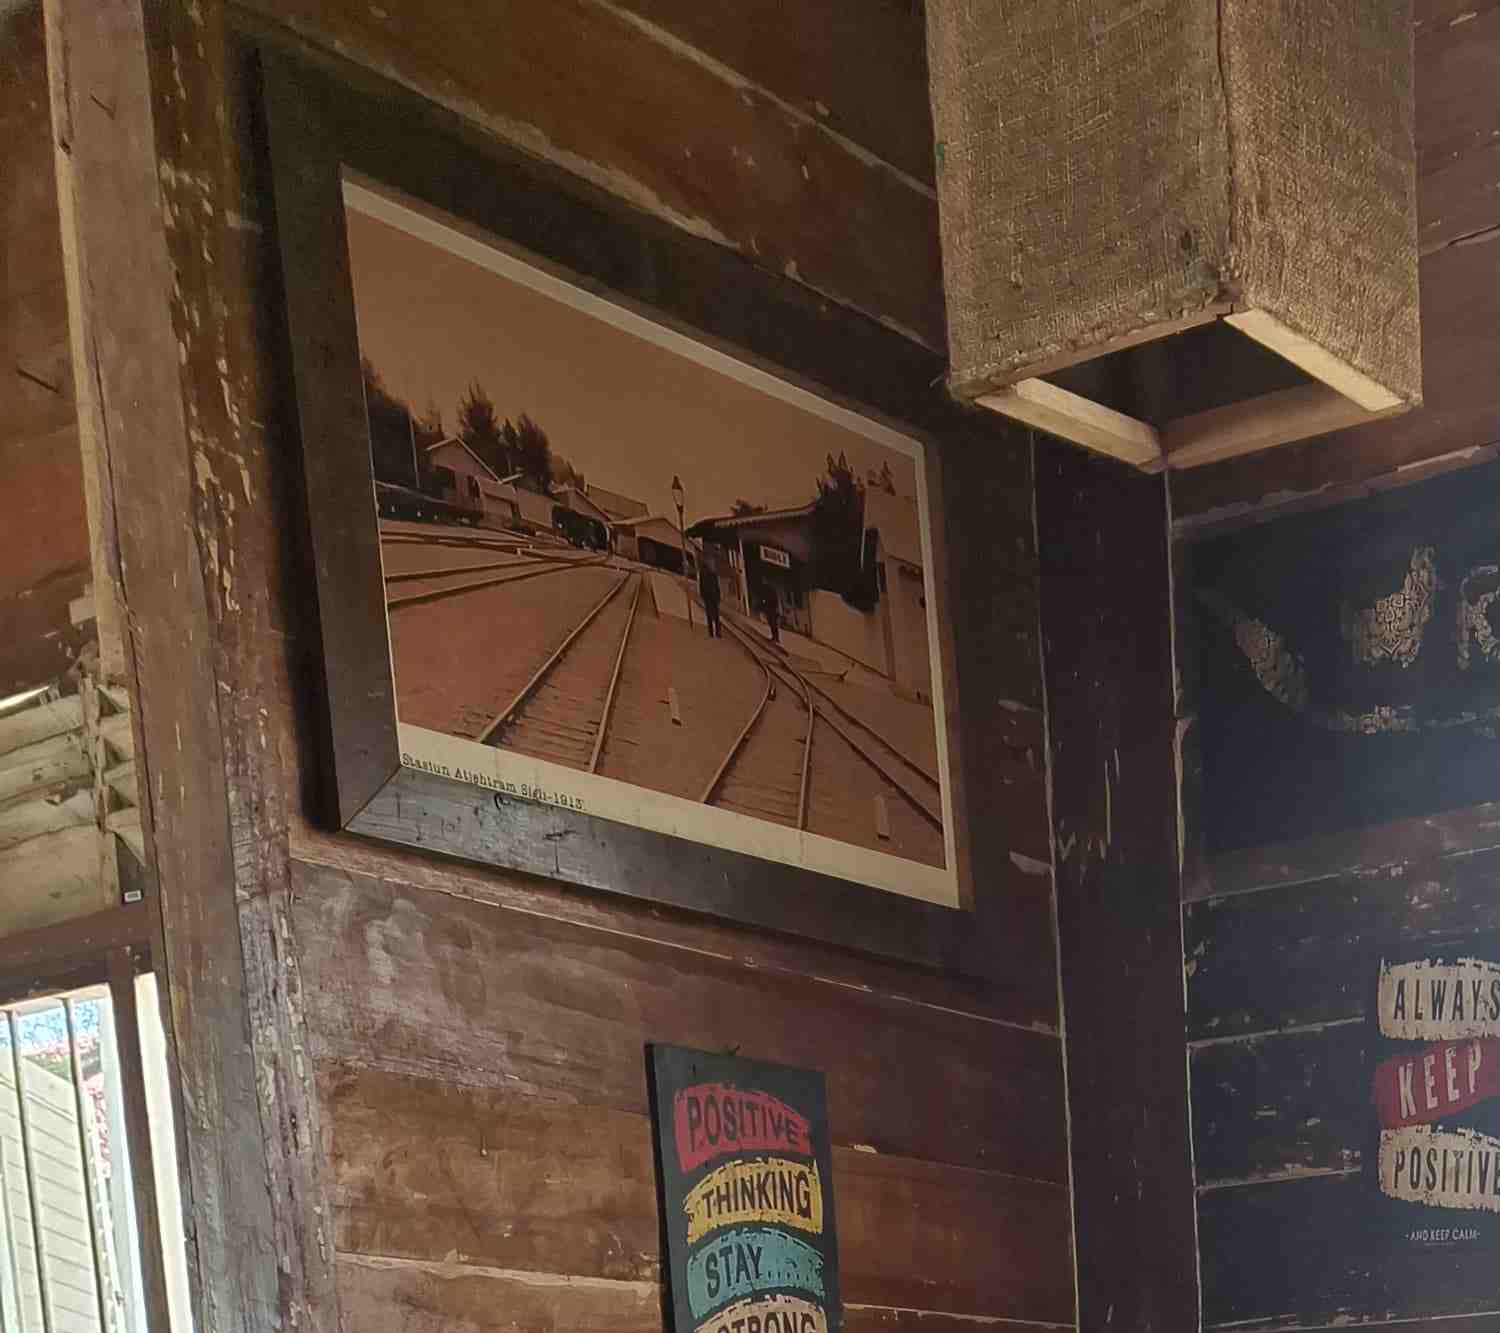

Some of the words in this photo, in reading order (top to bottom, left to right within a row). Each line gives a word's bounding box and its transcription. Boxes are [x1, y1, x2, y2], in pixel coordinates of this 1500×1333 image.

[1393, 979, 1500, 1021] ALWAYS
[1398, 1039, 1482, 1120] KEEP
[687, 1094, 799, 1152] POSITIVE
[702, 1171, 811, 1218] THINKING
[705, 1246, 762, 1298] STAY
